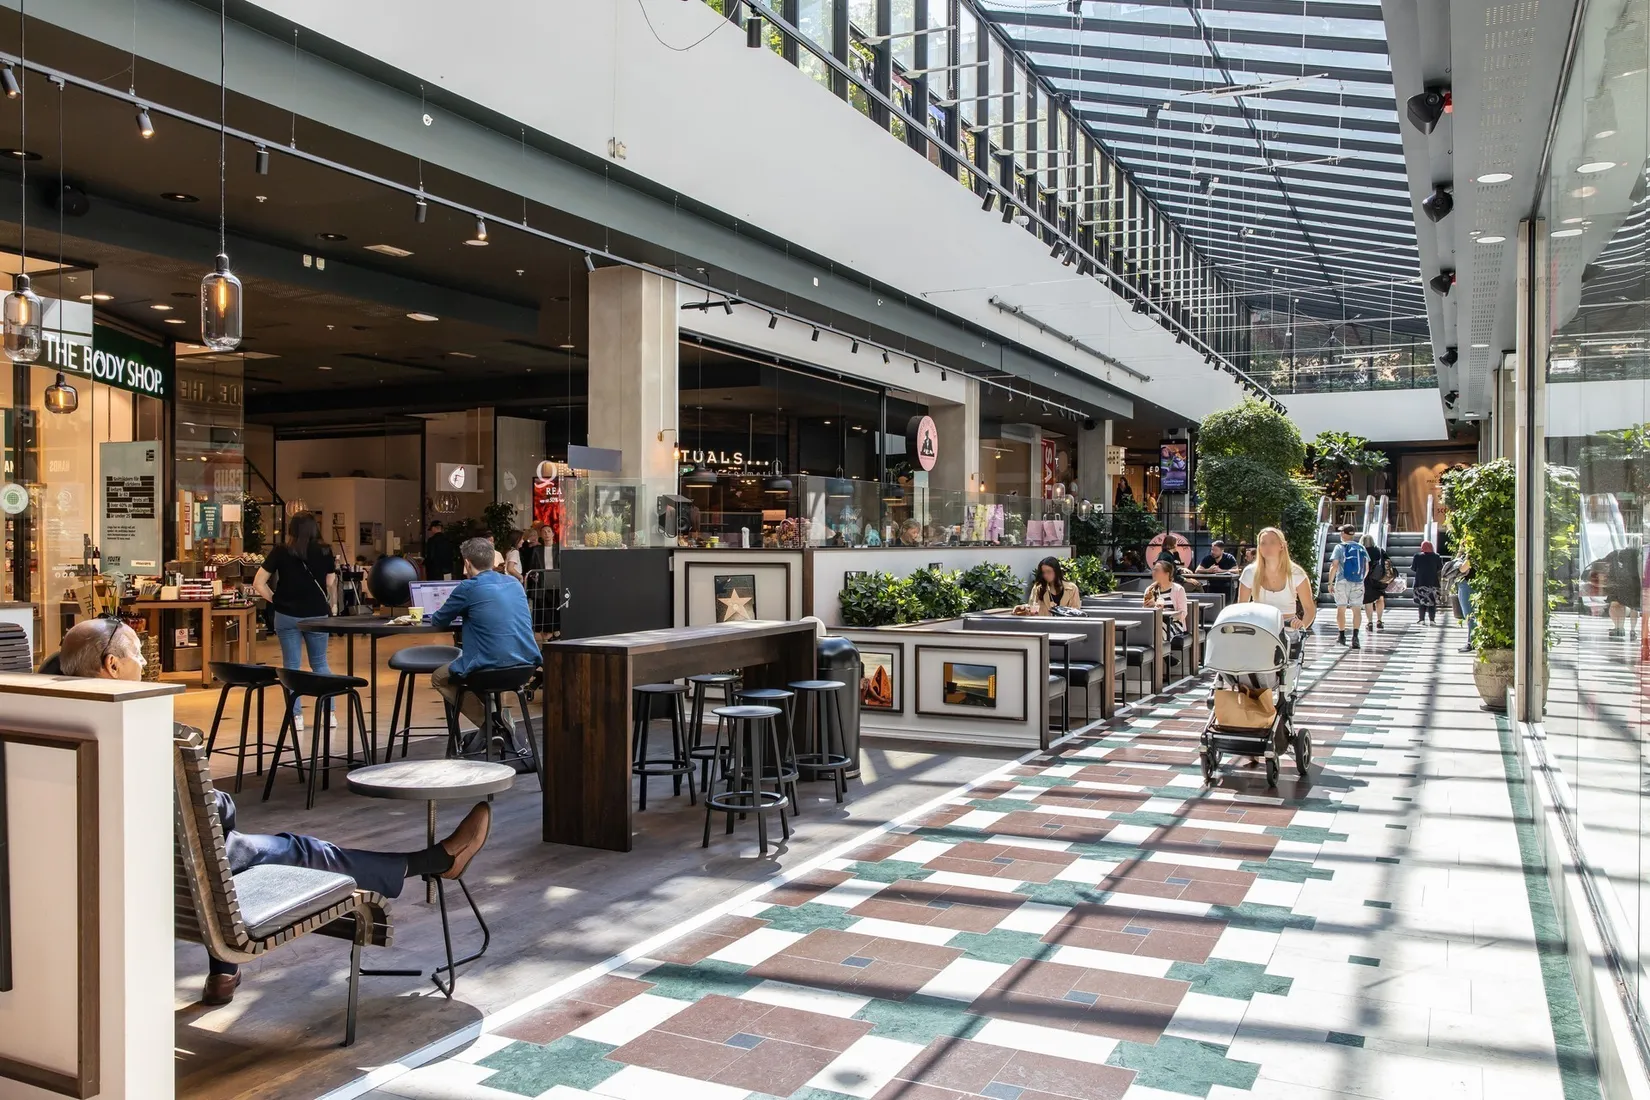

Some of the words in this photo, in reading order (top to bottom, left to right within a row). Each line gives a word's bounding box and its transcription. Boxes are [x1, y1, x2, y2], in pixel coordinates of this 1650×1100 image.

[43, 333, 78, 370] THE
[83, 346, 126, 383] BODY
[127, 360, 164, 395] SHOP.
